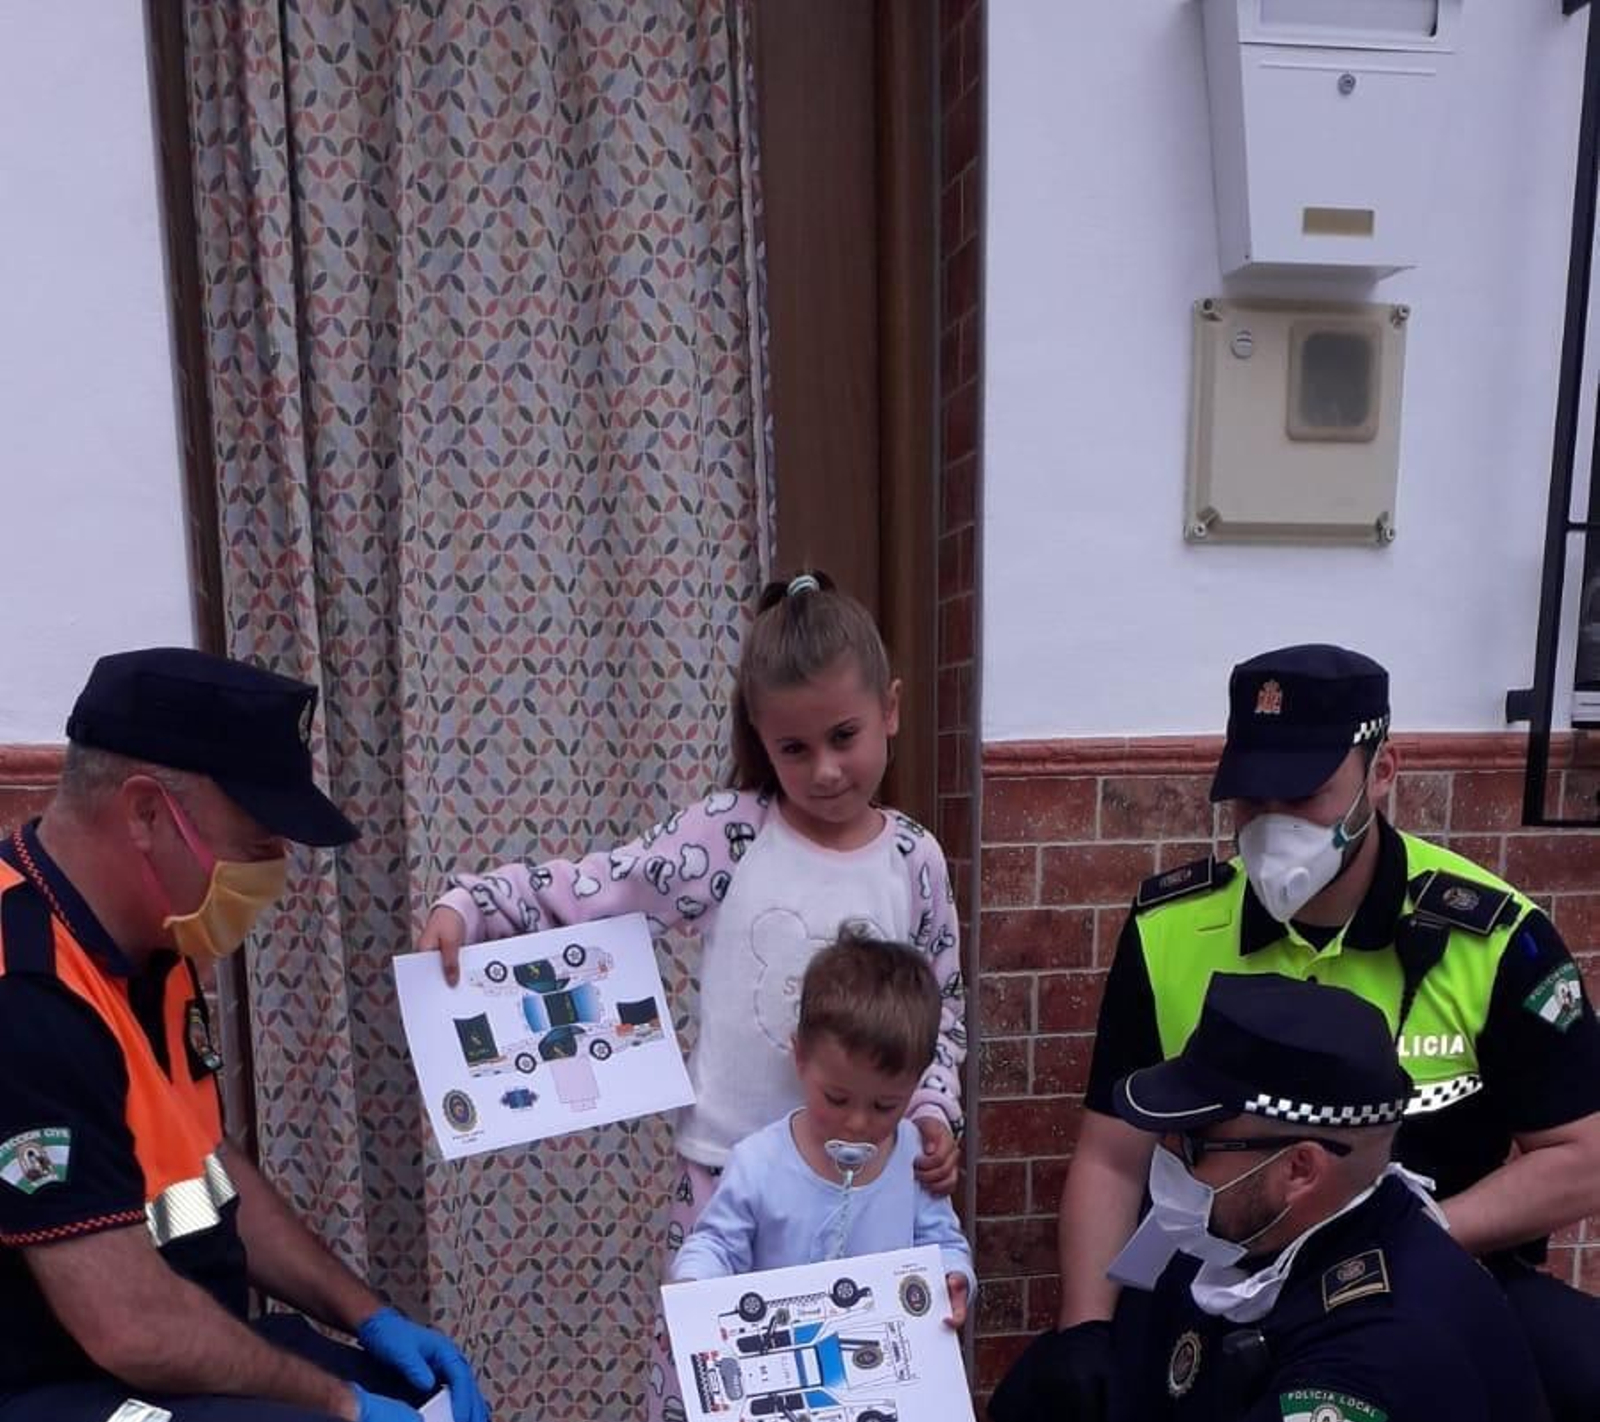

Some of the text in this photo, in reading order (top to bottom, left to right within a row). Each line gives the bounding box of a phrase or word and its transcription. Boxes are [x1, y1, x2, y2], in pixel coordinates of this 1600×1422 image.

[1396, 1034, 1465, 1057] LICIA
[1287, 1390, 1377, 1418] POLICIA LOCAL
